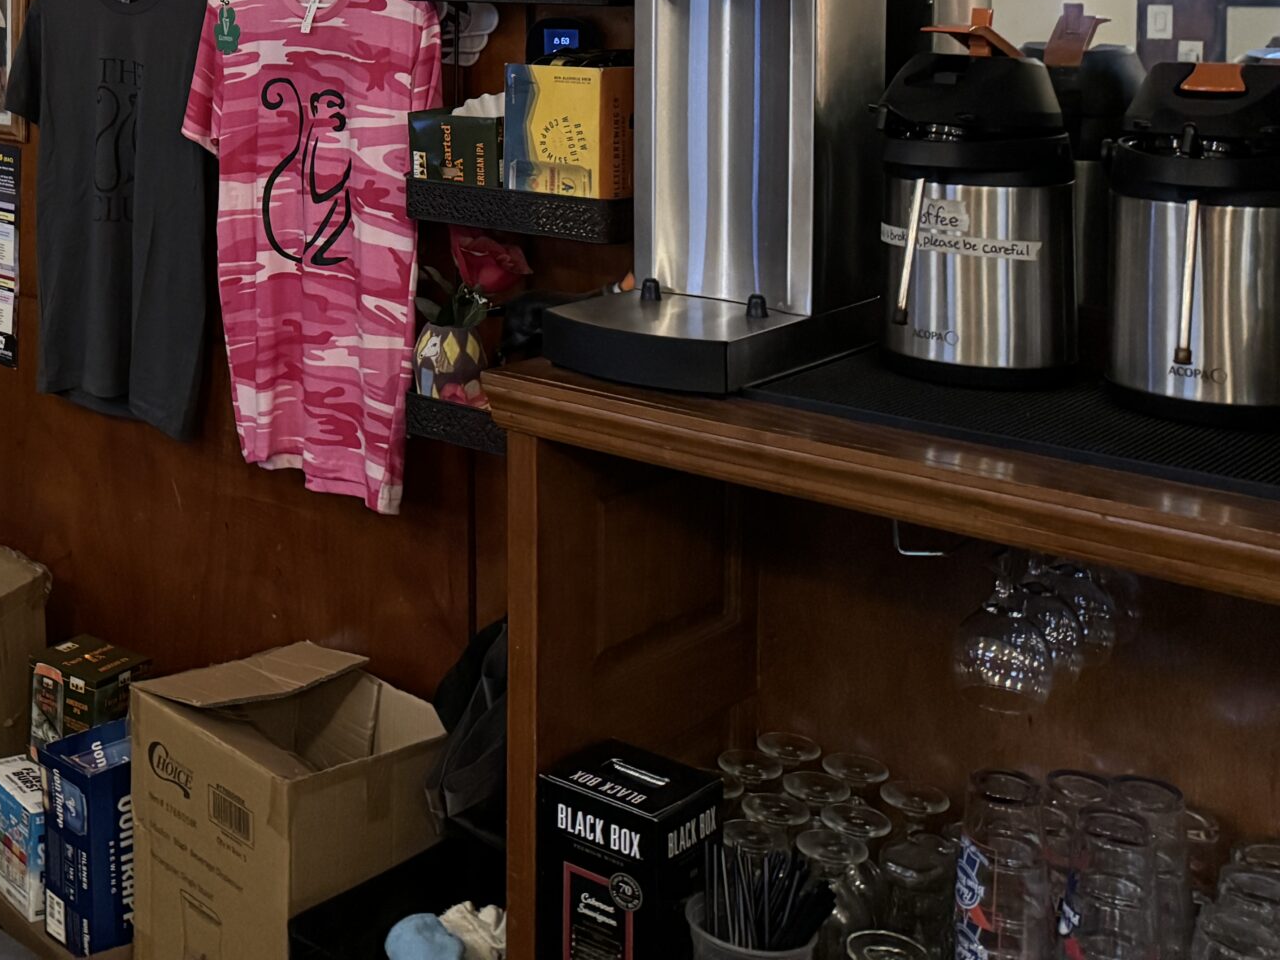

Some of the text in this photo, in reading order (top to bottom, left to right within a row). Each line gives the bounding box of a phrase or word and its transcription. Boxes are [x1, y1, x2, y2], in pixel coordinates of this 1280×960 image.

[561, 116, 580, 163] WITHOUT
[574, 123, 588, 151] BREW
[477, 156, 485, 186] ERICAN
[920, 204, 959, 227] offee
[923, 236, 960, 251] please
[963, 239, 977, 251] be
[982, 244, 1030, 257] careful
[912, 330, 944, 342] ACOPA
[1168, 366, 1209, 382] ACOPA
[148, 741, 194, 800] CHOICE
[569, 770, 647, 805] BLACK BOX
[557, 803, 641, 859] BLACK BOX
[668, 805, 717, 859] BLACK BOX
